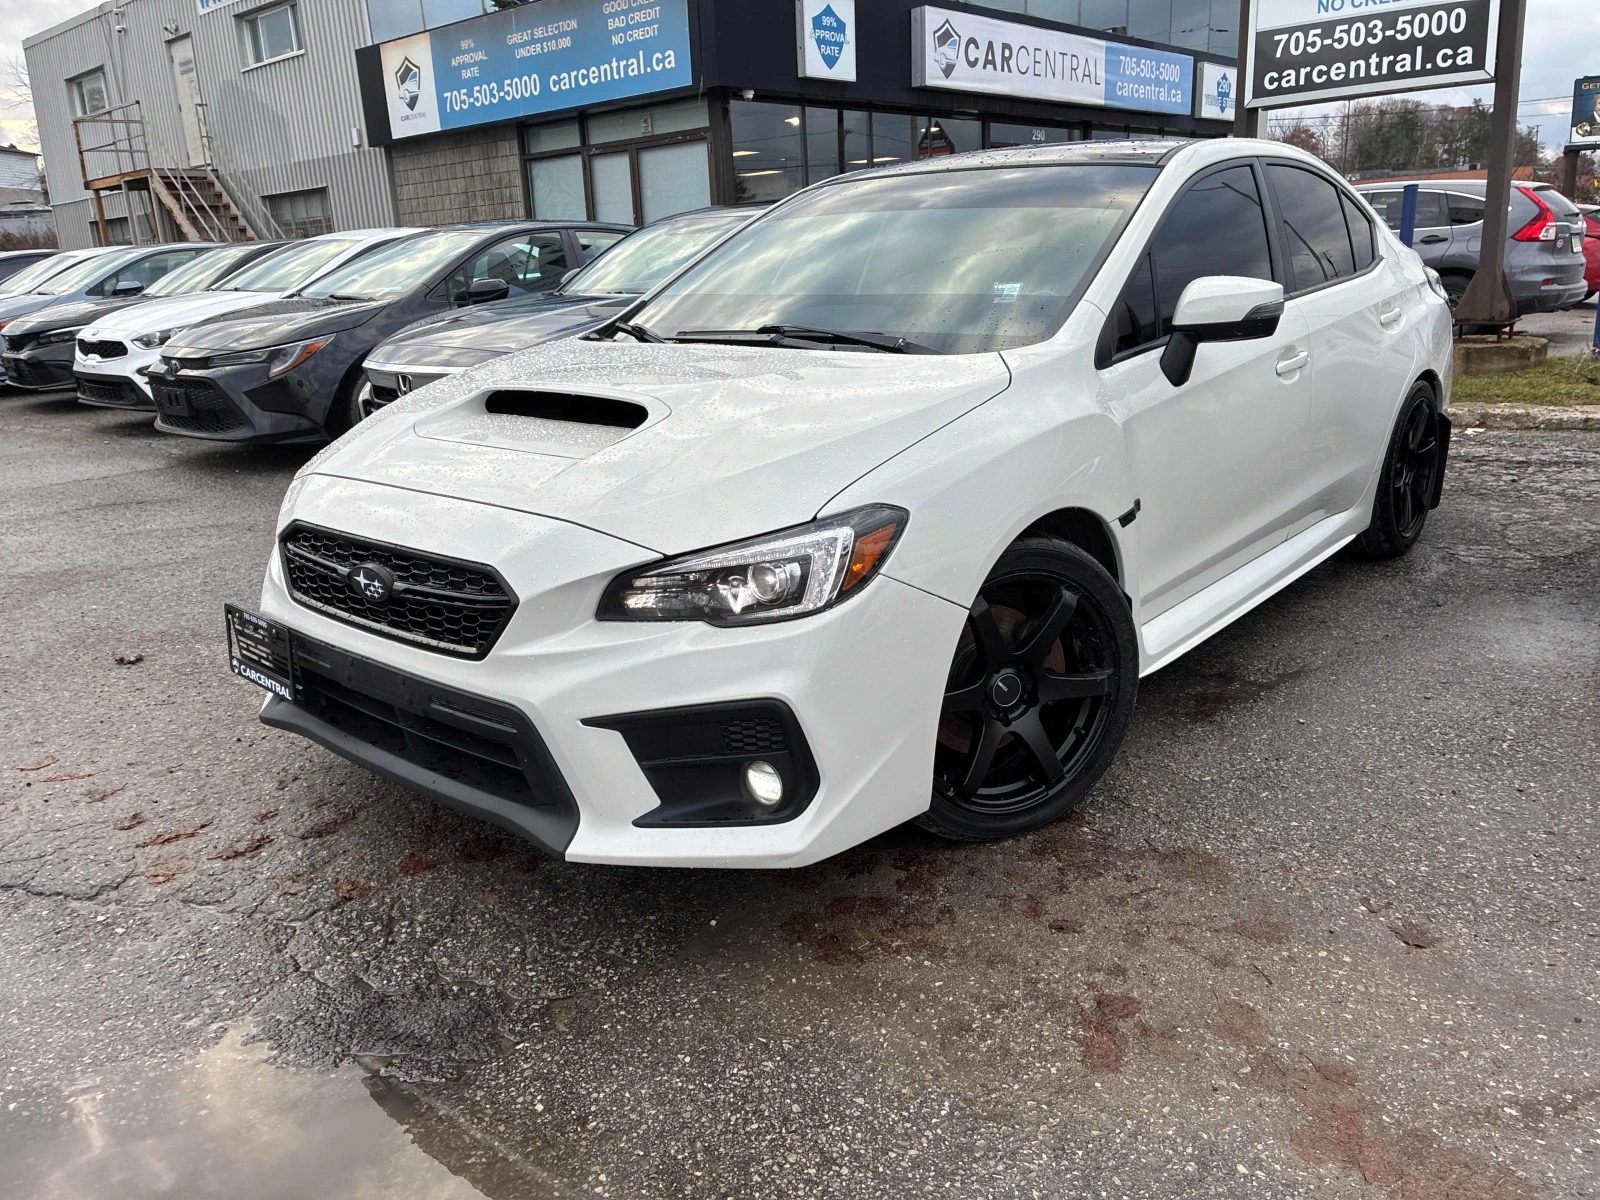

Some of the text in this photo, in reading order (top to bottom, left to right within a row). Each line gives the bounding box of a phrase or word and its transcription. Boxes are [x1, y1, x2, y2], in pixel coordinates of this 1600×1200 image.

[603, 0, 629, 14] GOOD
[1317, 0, 1345, 14] NO
[607, 7, 661, 30] BAD CREDIT
[821, 15, 837, 28] 99%
[506, 18, 578, 45] GREAT SELECTION
[611, 24, 659, 46] NO CREDIT
[809, 28, 850, 44] APPROVAL
[1273, 7, 1467, 58] 705-503-5000
[460, 38, 475, 50] 99%
[515, 36, 571, 59] UNDER $10,000
[820, 44, 840, 57] RATE
[451, 50, 488, 67] APPROVAL
[964, 36, 1101, 86] CARCENTRAL
[1119, 55, 1180, 83] 705-503-5000
[1263, 45, 1473, 90] carcentral.ca
[461, 66, 480, 80] RATE
[549, 49, 676, 92] carcentral.ca
[443, 73, 540, 113] 705-503-5000
[1116, 81, 1182, 103] carcentral.ca
[1218, 79, 1230, 93] 290
[1032, 129, 1046, 141] 290
[240, 664, 292, 700] CARCENTRAL
